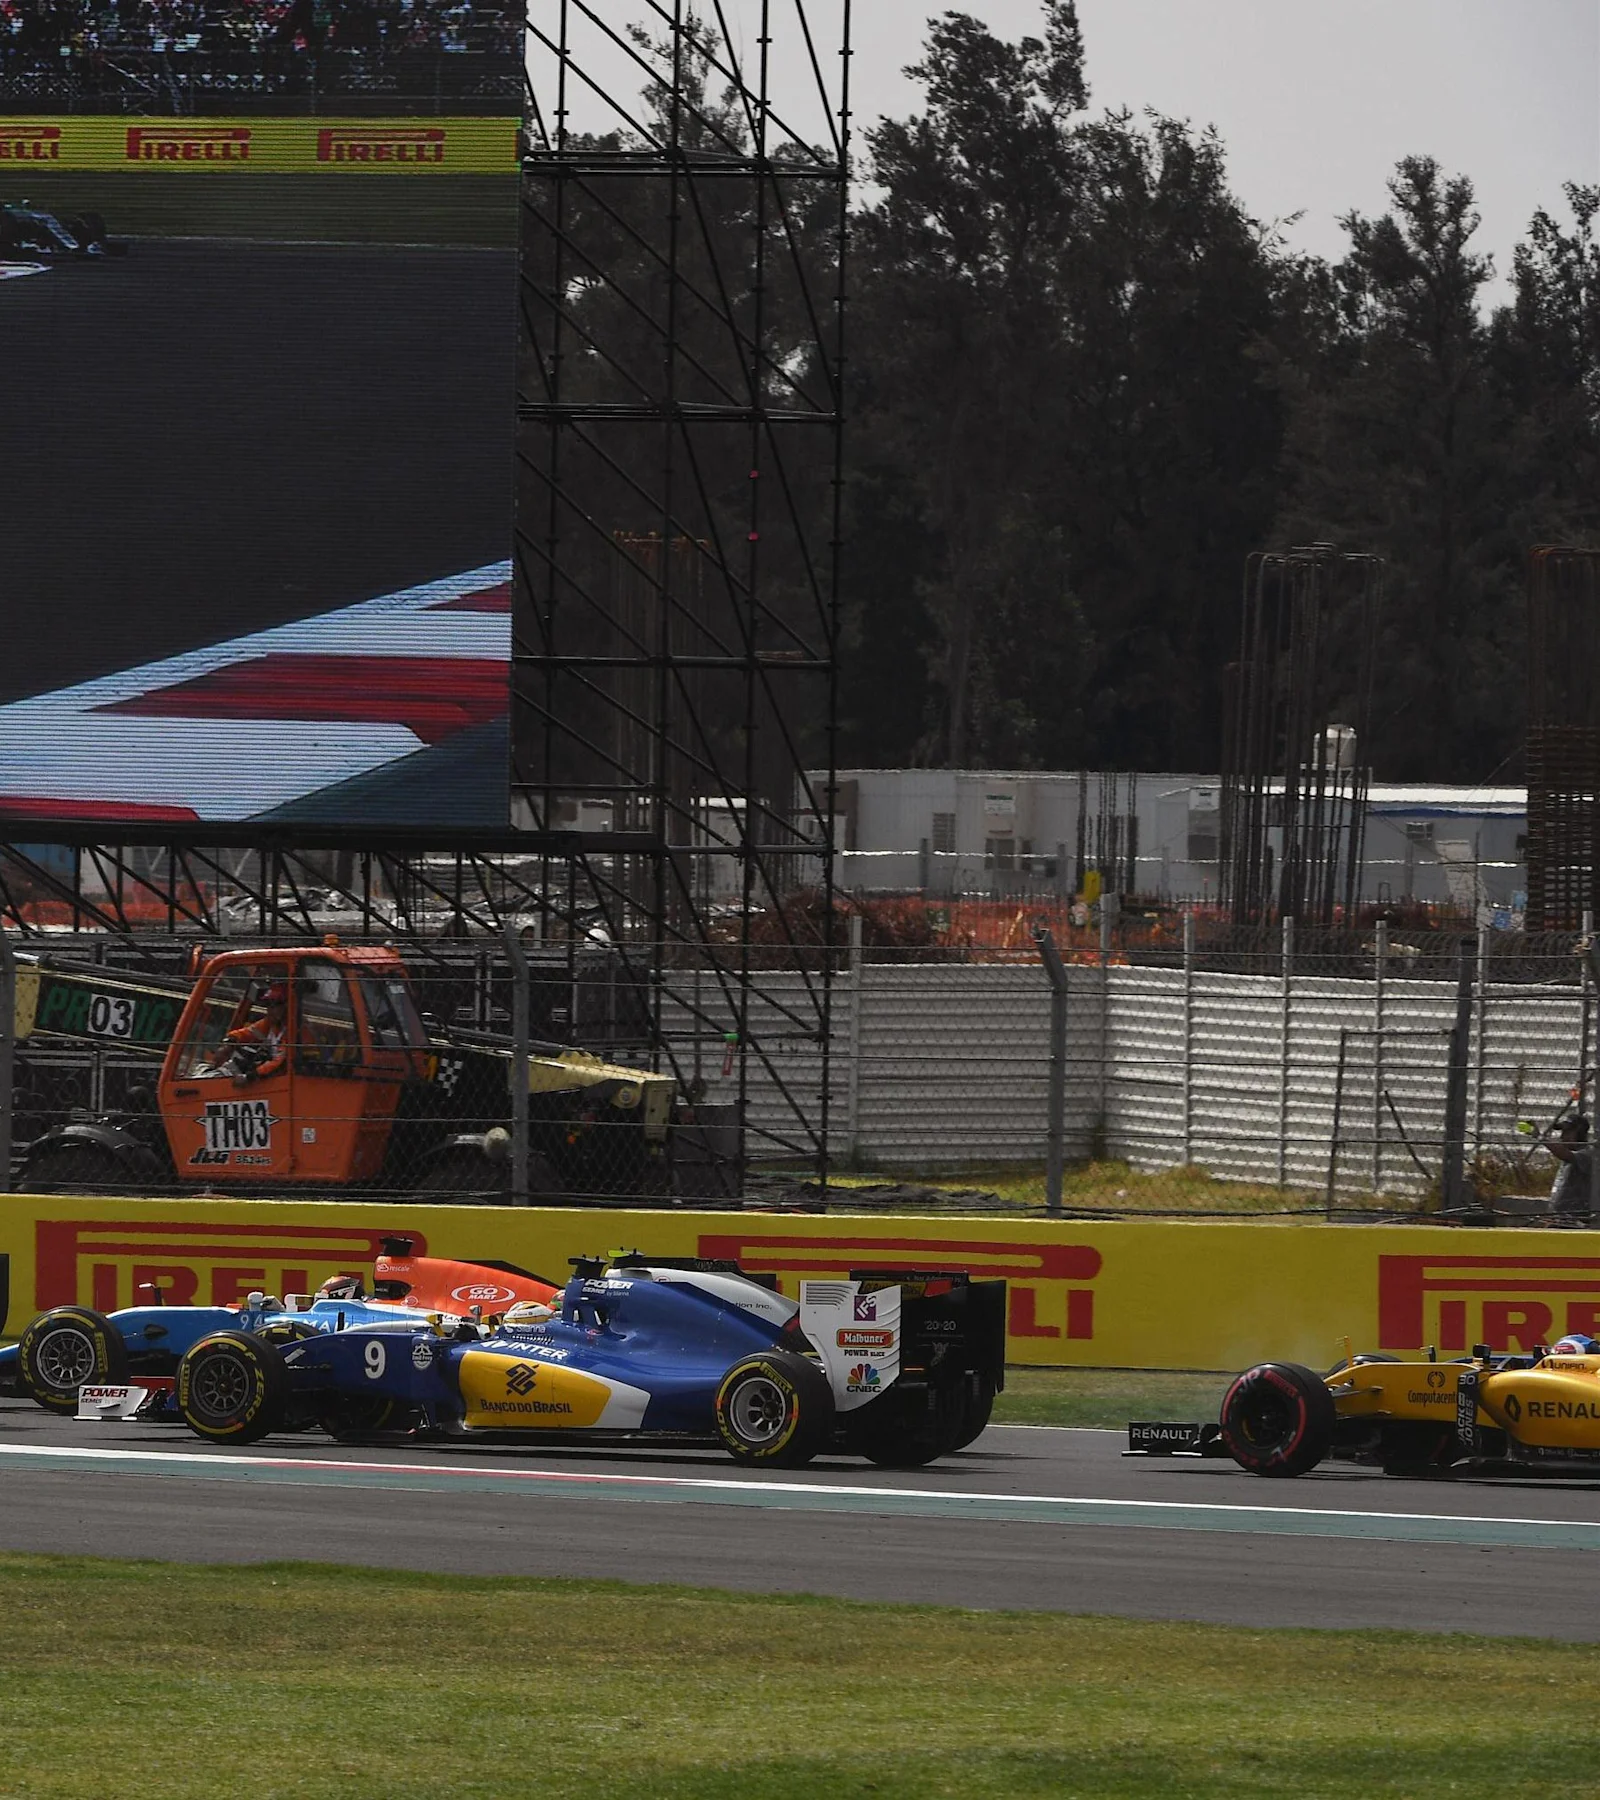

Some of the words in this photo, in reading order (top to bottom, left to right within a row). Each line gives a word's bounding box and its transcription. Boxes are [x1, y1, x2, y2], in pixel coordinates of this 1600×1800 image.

[126, 127, 253, 161] PIRELLI
[317, 128, 446, 162] PIRELLI
[91, 996, 132, 1036] 03
[205, 1102, 268, 1148] TH03
[469, 1286, 498, 1294] GO
[584, 1278, 634, 1290] POWER
[856, 1295, 877, 1319] IFS
[844, 1332, 885, 1343] Malbuner
[364, 1340, 386, 1379] 9
[508, 1341, 569, 1360] INTER
[759, 1361, 794, 1394] PIRELLI
[846, 1385, 881, 1393] CNBC
[1460, 1374, 1476, 1386] 30
[82, 1388, 129, 1398] POWER
[246, 1368, 265, 1422] ZERO
[1408, 1390, 1458, 1407] Computacent
[480, 1399, 517, 1413] BANCO
[517, 1402, 532, 1413] DO
[533, 1401, 573, 1413] BRASIL
[716, 1411, 749, 1454] ZERO
[1132, 1428, 1192, 1440] RENAULT
[1457, 1404, 1466, 1446] JACK
[1464, 1399, 1474, 1445] JONES
